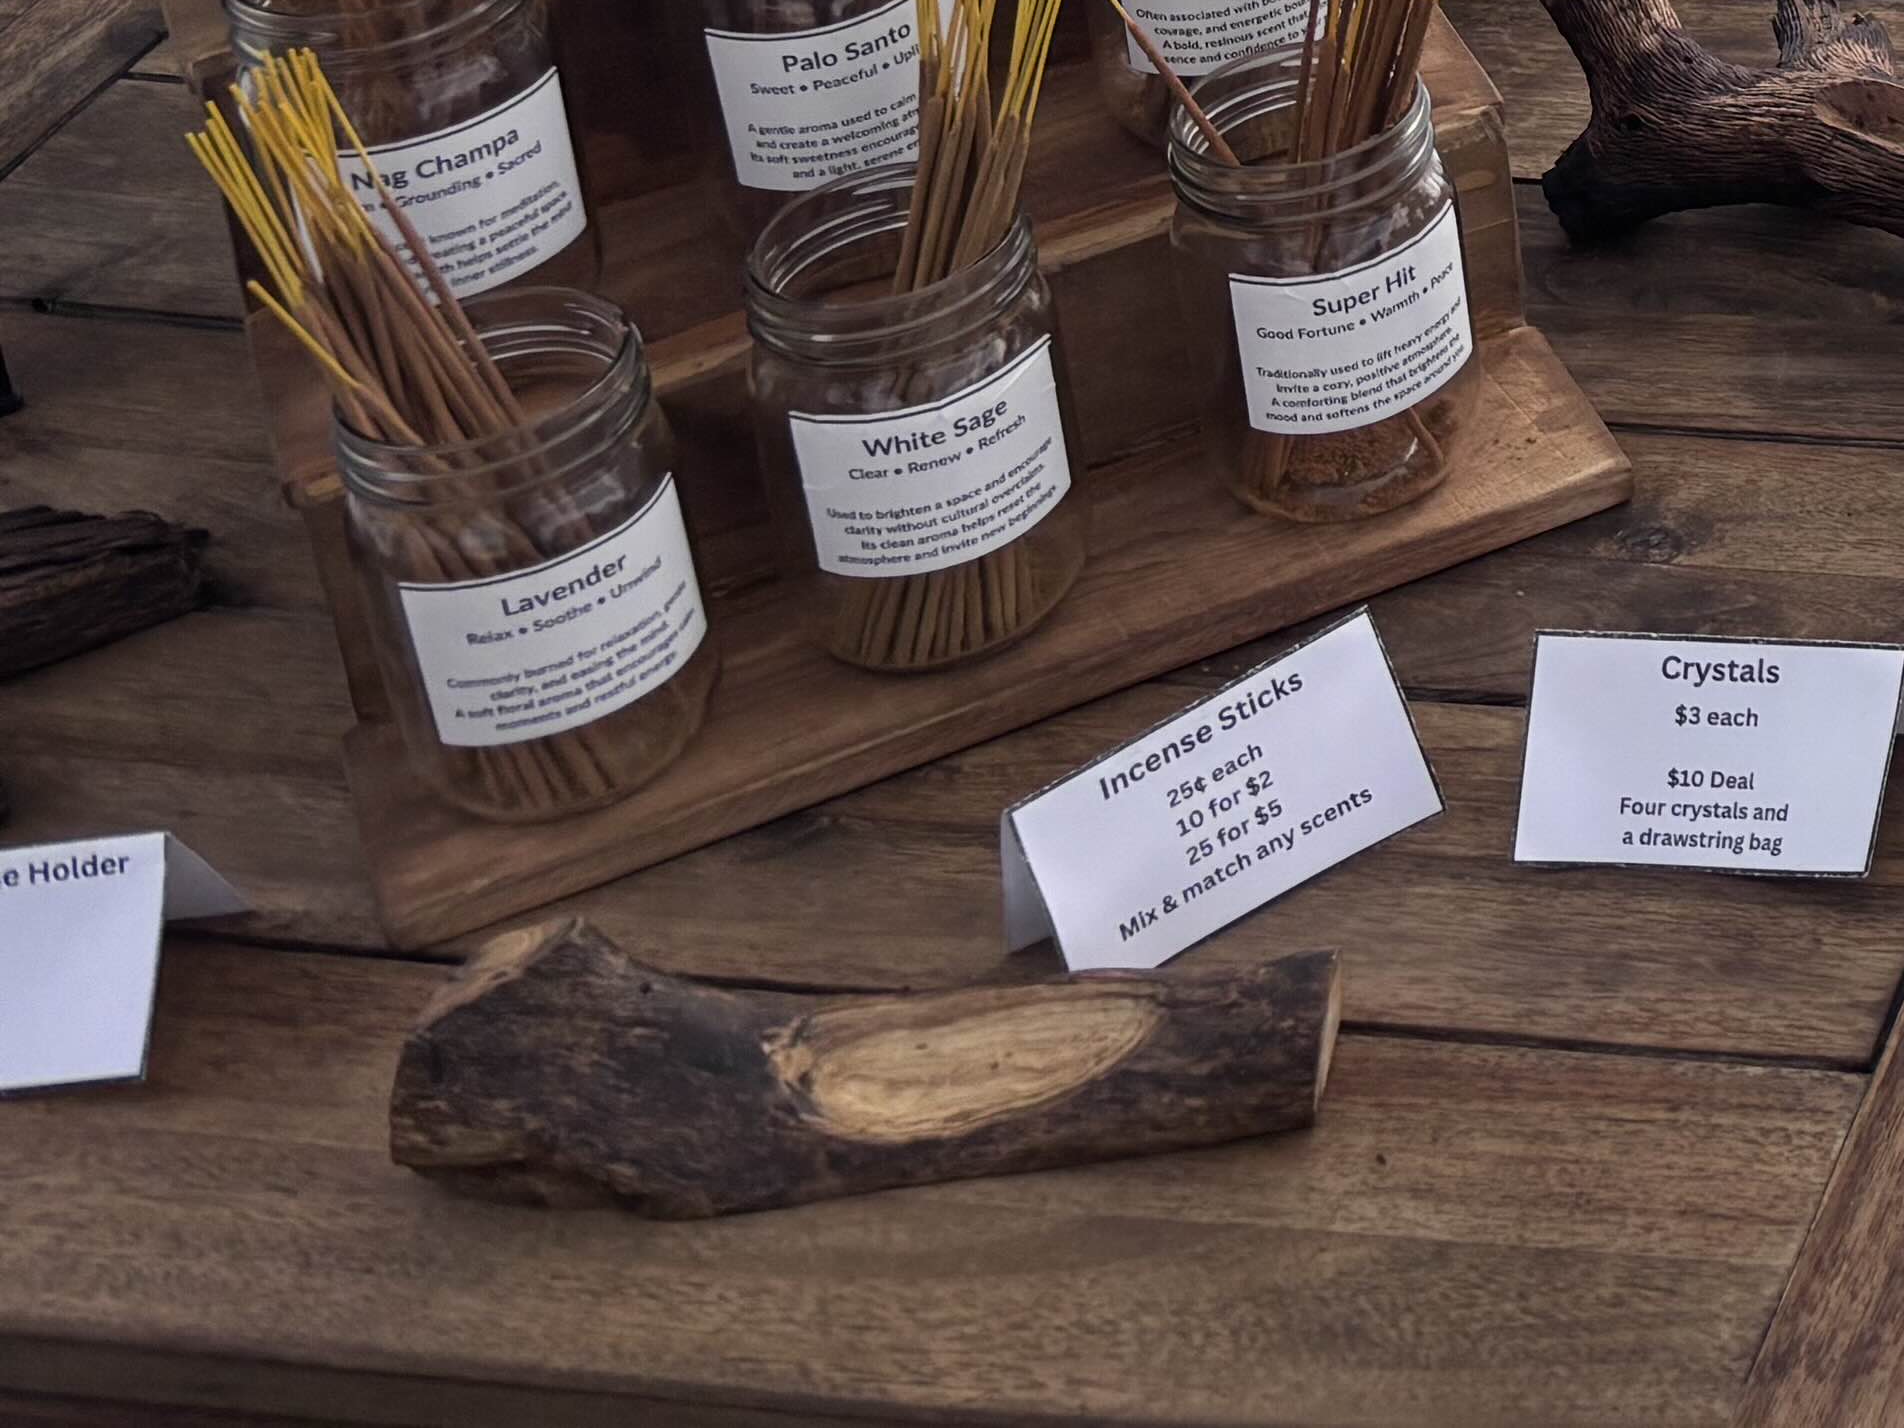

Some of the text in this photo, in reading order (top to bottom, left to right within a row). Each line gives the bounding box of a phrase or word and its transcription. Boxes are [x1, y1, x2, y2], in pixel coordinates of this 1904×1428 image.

[782, 24, 911, 72] Palo Santo
[750, 64, 878, 95] Sweet Peaceful
[416, 129, 519, 179] Champa
[497, 140, 542, 175] Sacred
[1312, 286, 1380, 316] Super
[1386, 266, 1416, 293] Hit
[1256, 327, 1294, 340] Good
[1298, 322, 1354, 338] Fortune
[848, 415, 1025, 480] Clear Renew Refresh
[862, 401, 1007, 457] White Sage
[501, 554, 626, 616] Lavender
[466, 631, 514, 645] Relax
[533, 603, 592, 632] Soothe
[1662, 656, 1779, 687] Crystals
[1099, 673, 1303, 800] Incense Sticks
[1675, 704, 1758, 727] $3 each
[1167, 744, 1263, 808] 25¢ each
[1667, 768, 1754, 790] $10 Deal
[1176, 771, 1273, 837] 10 for $2
[1620, 797, 1789, 822] Four crystals and
[1186, 799, 1282, 866] 25 for $5
[1622, 828, 1783, 856] a drawstring bag
[29, 854, 130, 884] Holder
[1119, 789, 1372, 941] Mix & match any scents
